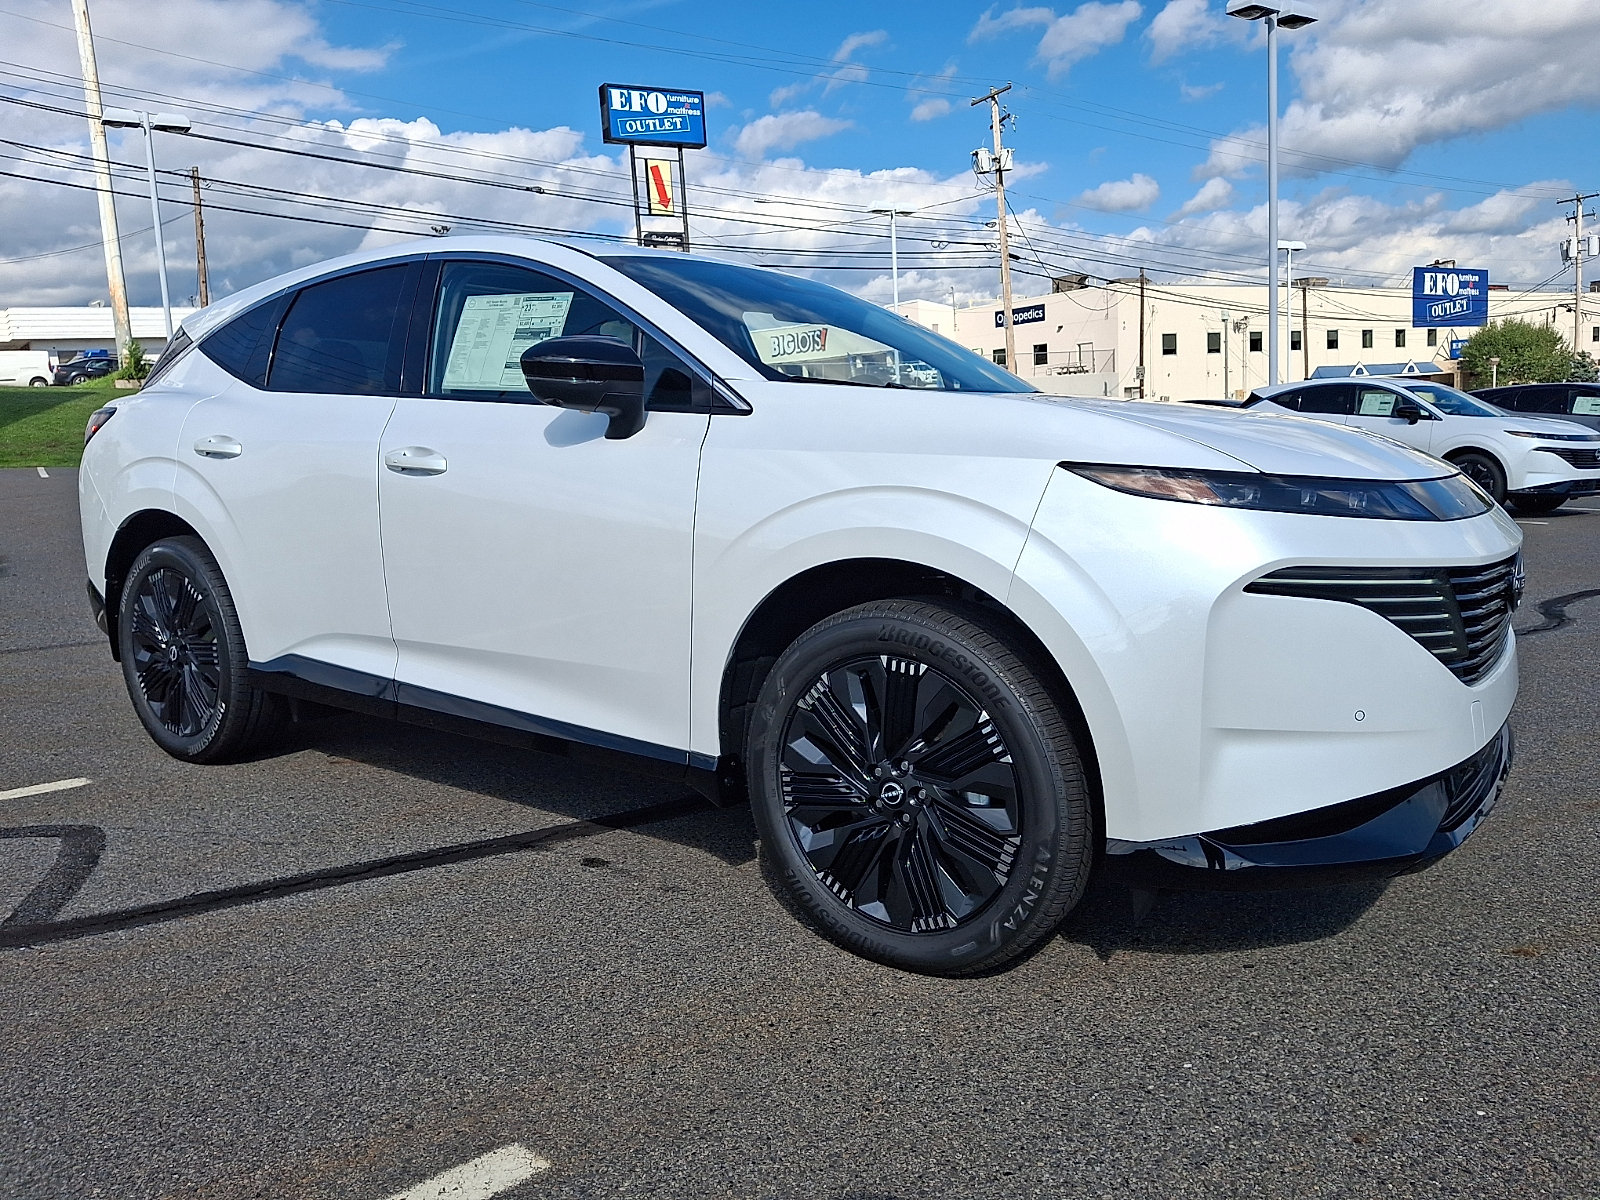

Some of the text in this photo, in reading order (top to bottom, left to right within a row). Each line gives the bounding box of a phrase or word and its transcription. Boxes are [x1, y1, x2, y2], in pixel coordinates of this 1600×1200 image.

[609, 88, 668, 114] EFO
[667, 94, 700, 104] furniture
[667, 107, 701, 116] mattress
[625, 117, 683, 133] OUTLET
[1423, 272, 1460, 296] EFO
[1459, 273, 1479, 282] furniture
[1458, 288, 1480, 296] mattress
[1431, 299, 1468, 317] OUTLET
[996, 309, 1043, 323] Oopedics
[1003, 845, 1051, 931] ALENZA
